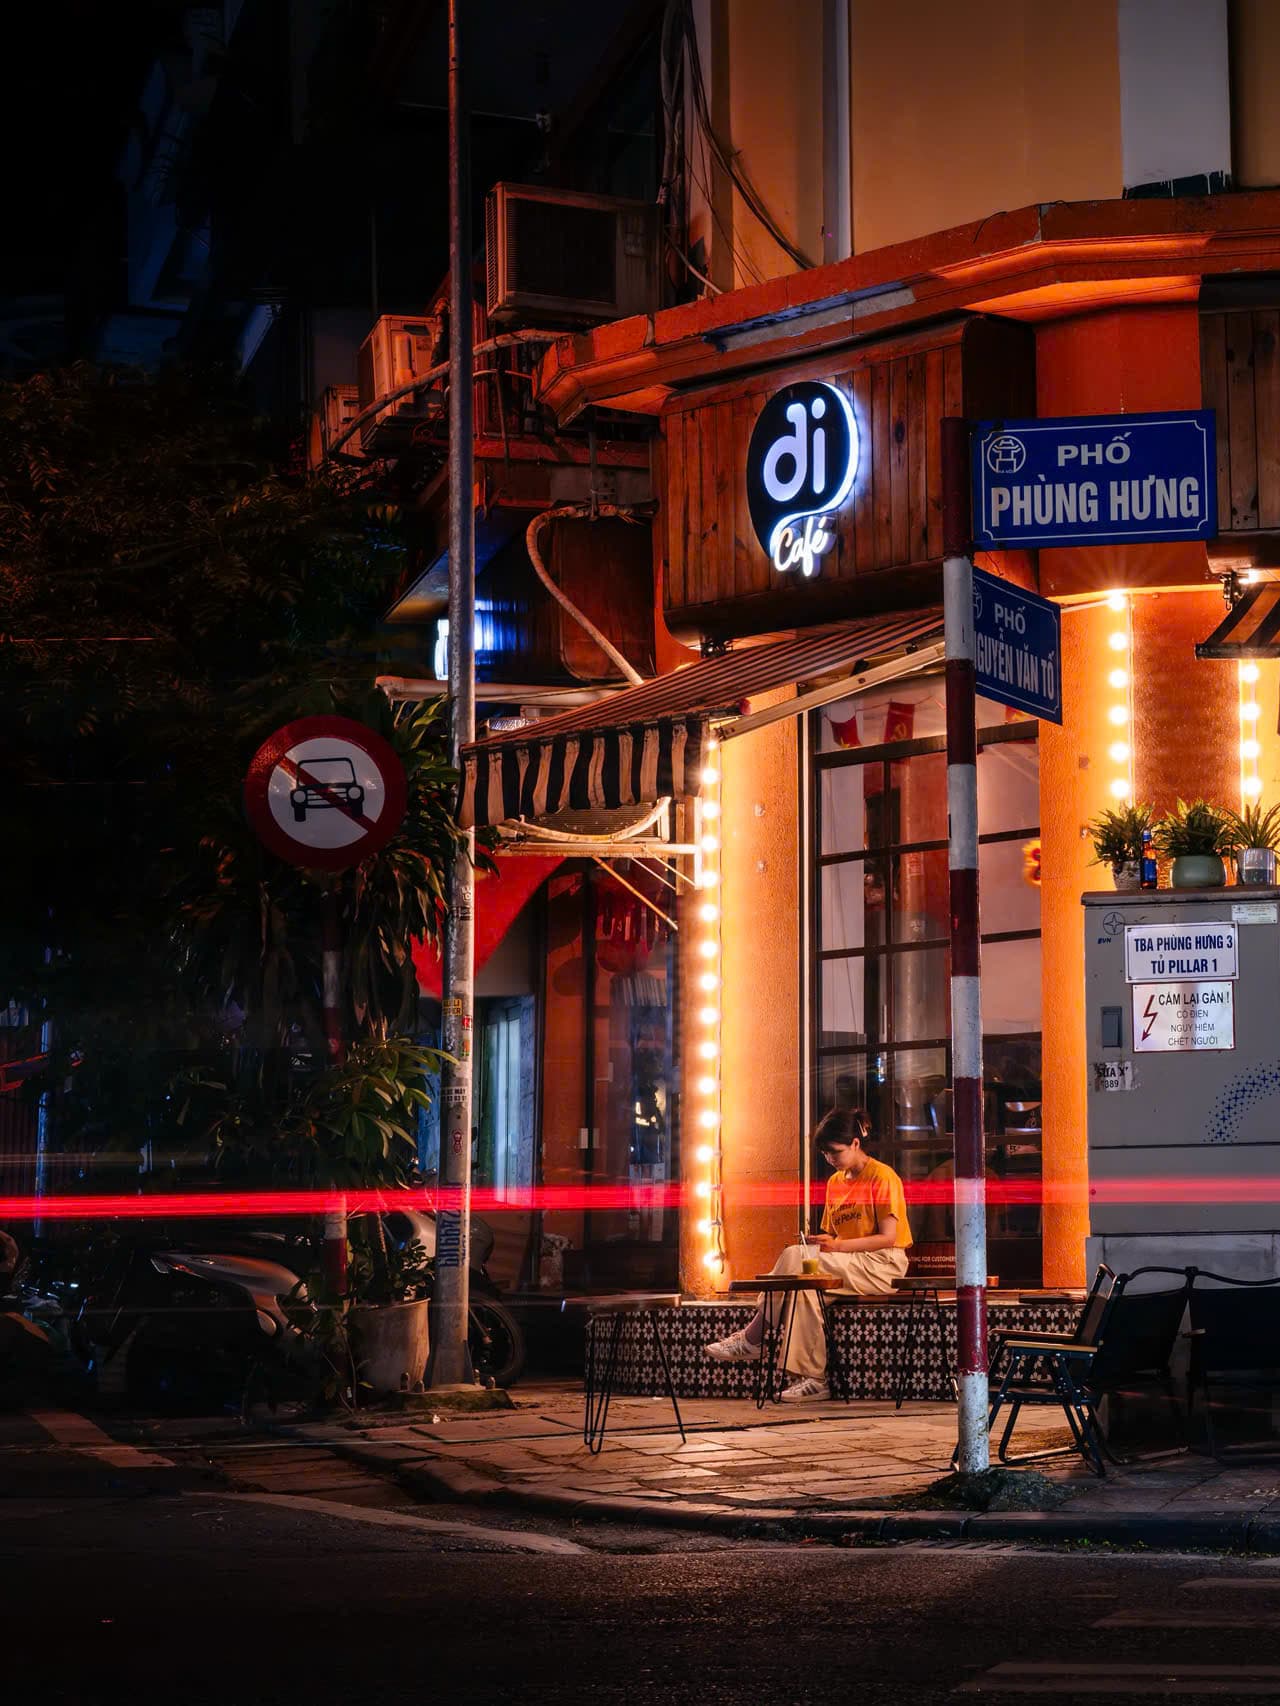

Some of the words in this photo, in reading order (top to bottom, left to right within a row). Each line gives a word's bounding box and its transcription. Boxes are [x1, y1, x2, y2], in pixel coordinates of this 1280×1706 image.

[763, 398, 826, 502] di
[1057, 431, 1133, 467] PHỐ
[991, 474, 1099, 527] PHÙNG
[1110, 474, 1199, 521] HƯNG
[774, 516, 830, 577] Café
[994, 605, 1027, 634] PHỐ
[975, 628, 1014, 685] GUYỄN
[1016, 643, 1039, 694] VĂN
[1134, 938, 1153, 952] TBA
[1157, 934, 1192, 951] PHÙNG
[1195, 934, 1223, 950] HƯNG
[1226, 935, 1233, 949] 3
[1151, 954, 1165, 974] TỦ
[1168, 958, 1208, 973] PILLAR
[1212, 958, 1218, 972] 1
